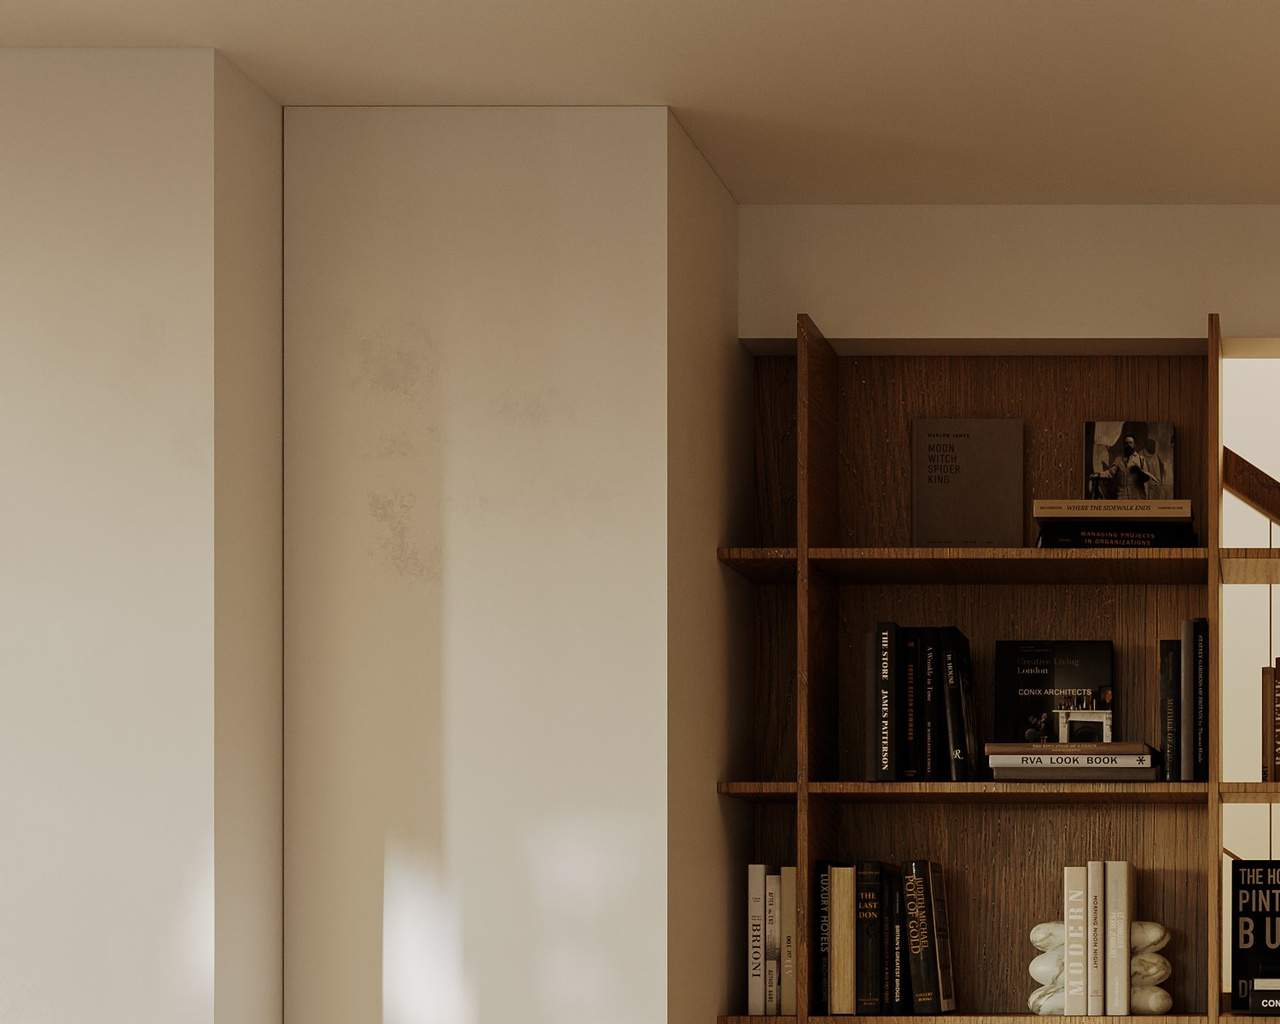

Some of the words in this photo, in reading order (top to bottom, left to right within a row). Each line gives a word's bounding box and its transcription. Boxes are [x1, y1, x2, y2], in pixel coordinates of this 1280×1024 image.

[927, 443, 955, 453] MOON
[927, 454, 957, 463] WITCH
[927, 464, 961, 474] SPIDER
[927, 475, 950, 485] KING
[881, 630, 889, 649] THE
[881, 651, 889, 680] STORE
[947, 662, 955, 685] HOUSE
[1017, 667, 1048, 675] London
[1054, 657, 1080, 667] Living
[1018, 688, 1042, 696] CONIX
[1043, 688, 1093, 696] ARCHITECTS
[881, 689, 889, 719] JAMES
[1167, 698, 1175, 731] MOTHER
[881, 720, 889, 771] PATTERSON
[905, 875, 916, 899] POT
[1238, 868, 1264, 885] THE
[820, 873, 829, 914] LUXURY
[916, 877, 926, 909] JUDITH
[859, 911, 878, 919] DON
[906, 901, 917, 917] OF
[820, 915, 829, 953] HOTELS
[908, 920, 921, 954] GOLD
[918, 910, 929, 949] MICHAEL
[751, 923, 761, 978] BRIONI
[1068, 890, 1084, 996] MODERN
